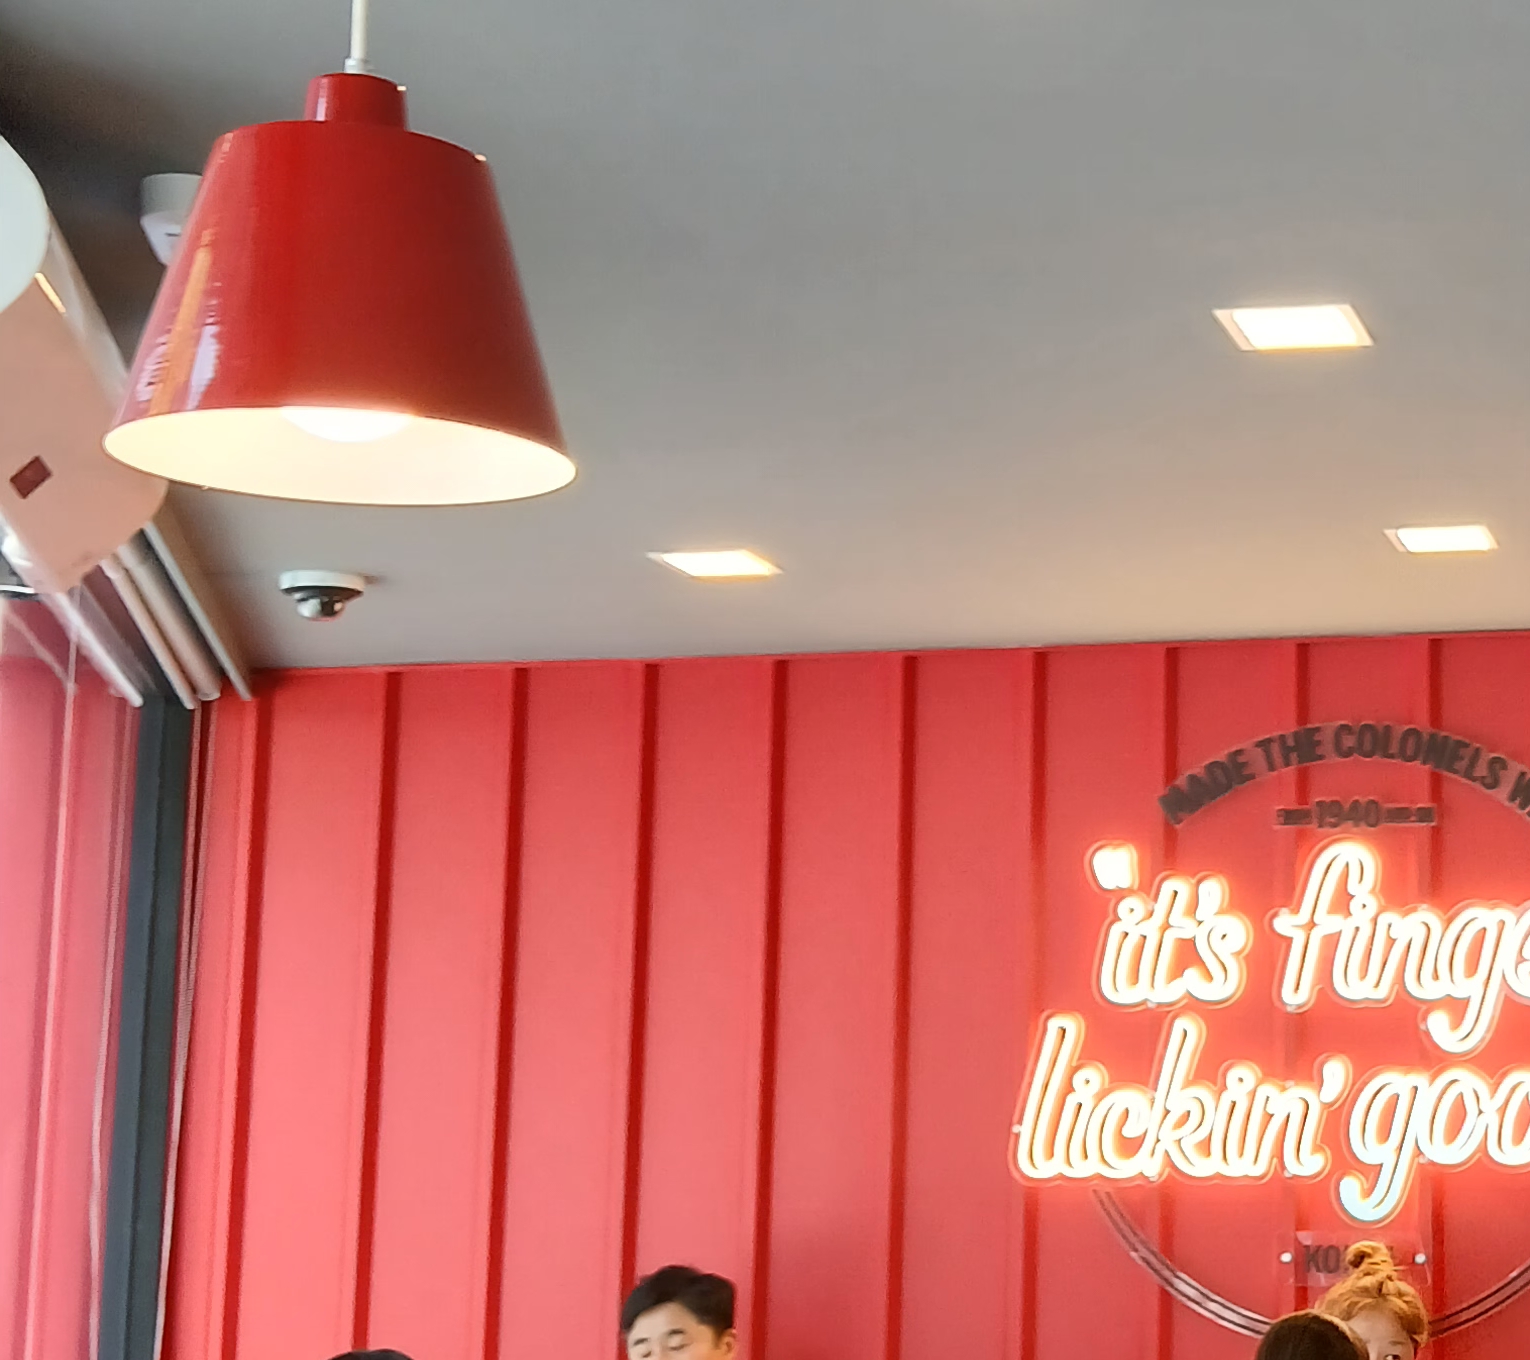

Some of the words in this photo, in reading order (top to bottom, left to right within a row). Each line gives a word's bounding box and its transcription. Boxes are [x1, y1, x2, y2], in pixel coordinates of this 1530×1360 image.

[1158, 761, 1256, 825] MADE
[1255, 726, 1326, 772] THE
[1315, 798, 1380, 829] 1940
